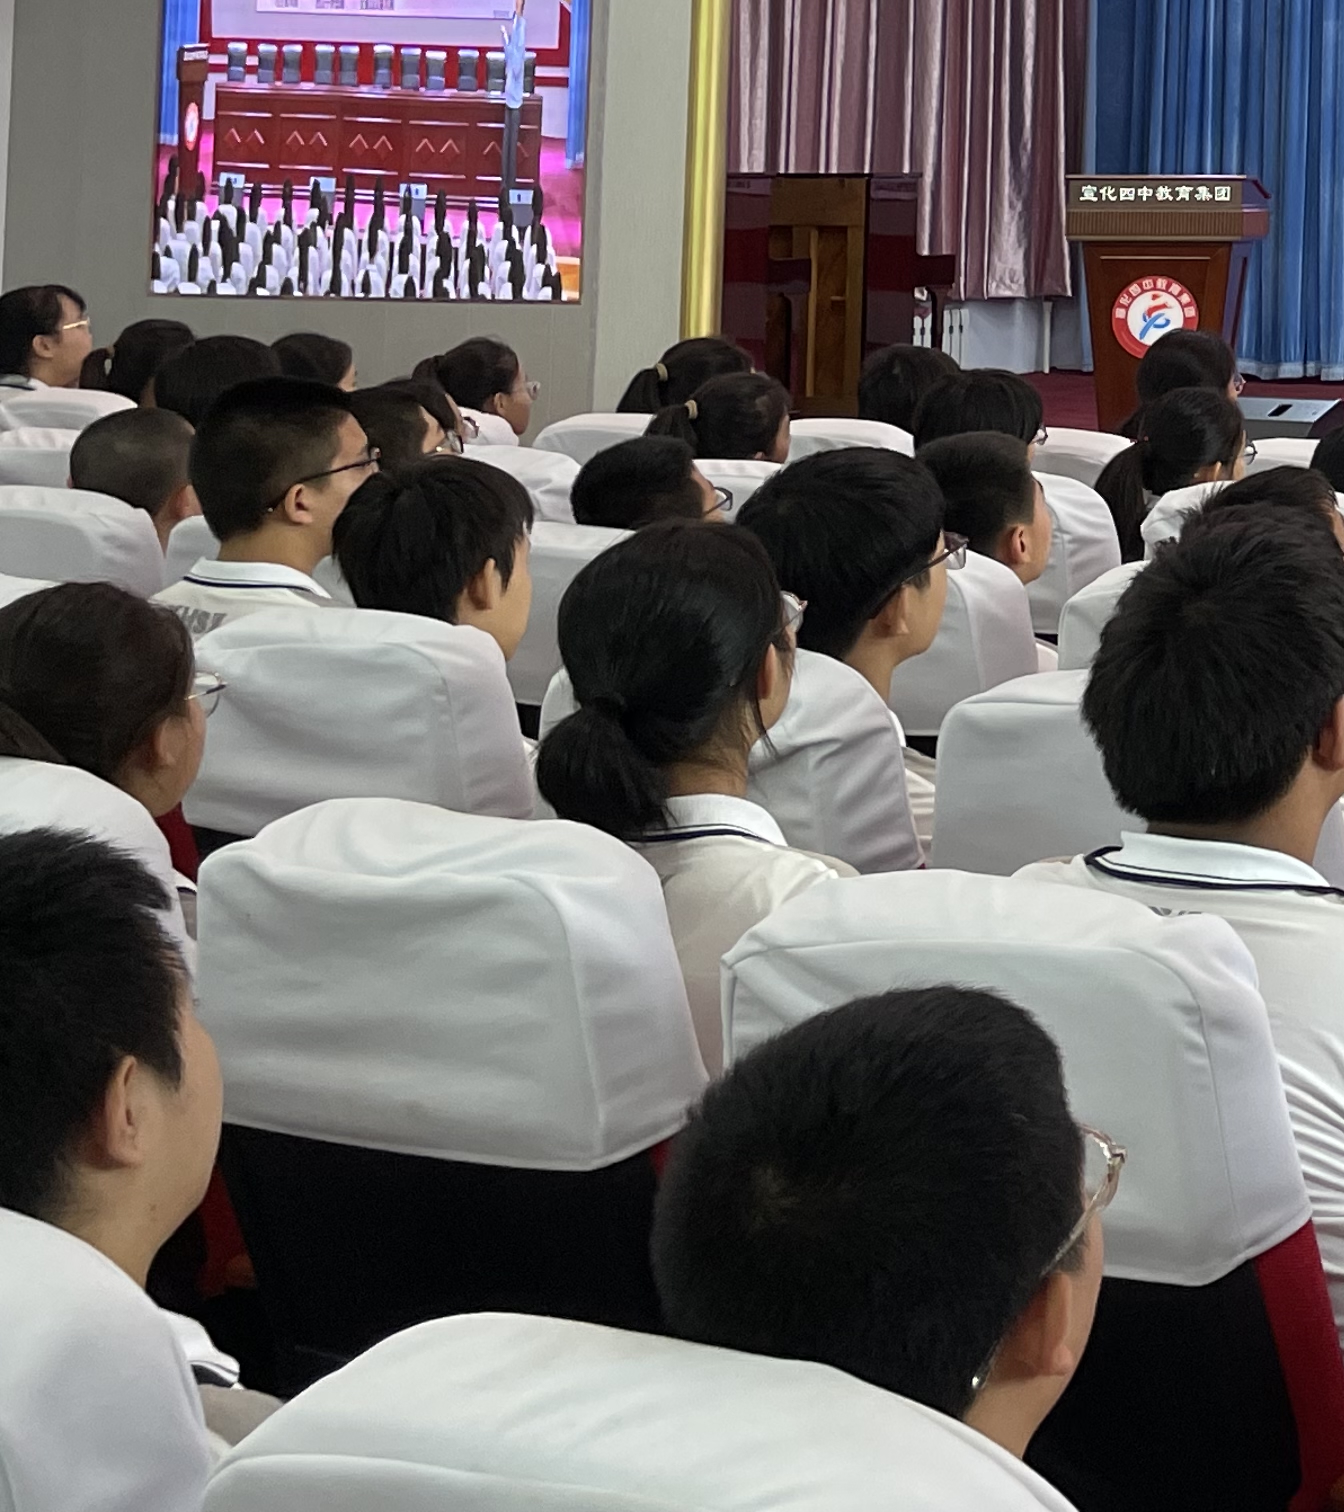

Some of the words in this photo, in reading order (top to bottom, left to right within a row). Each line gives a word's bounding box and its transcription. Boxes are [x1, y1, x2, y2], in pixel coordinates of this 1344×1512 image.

[1079, 184, 1231, 202] 宣化四中教育集团
